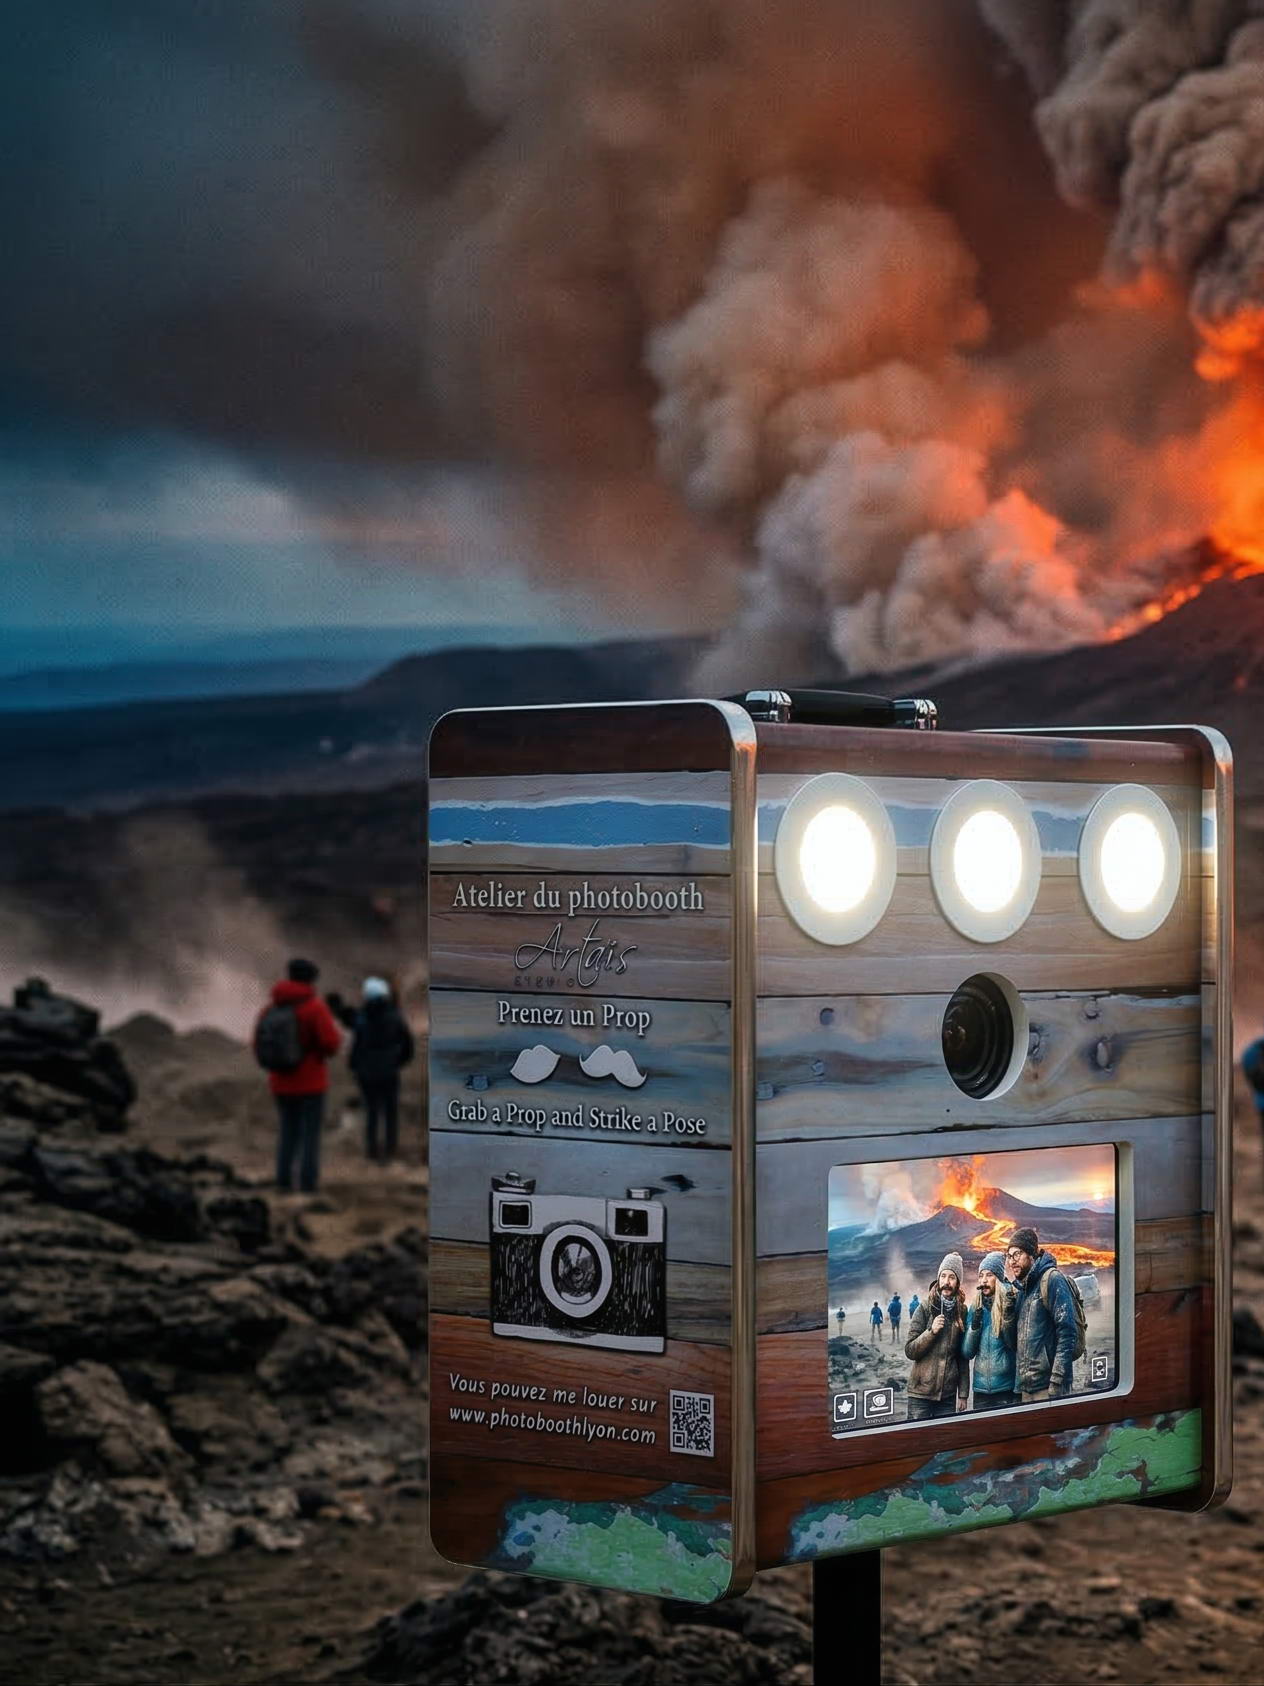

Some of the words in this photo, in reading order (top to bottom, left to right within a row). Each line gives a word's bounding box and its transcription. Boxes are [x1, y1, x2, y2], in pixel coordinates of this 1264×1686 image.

[452, 881, 527, 909] Atelier
[533, 882, 561, 909] du
[568, 882, 705, 916] photobooth
[497, 1000, 564, 1025] Prenez
[570, 1009, 596, 1026] un
[602, 1004, 651, 1037] Prop
[448, 1099, 488, 1121] Grab
[492, 1109, 501, 1122] a
[506, 1103, 546, 1131] Prop
[551, 1105, 584, 1128] and
[588, 1107, 641, 1131] Strike
[647, 1116, 657, 1133] a
[662, 1111, 706, 1134] Pose
[449, 1373, 486, 1394] Vous
[491, 1381, 547, 1401] pouvez
[553, 1387, 576, 1405] me
[582, 1387, 625, 1410] louer
[630, 1397, 657, 1413] sur
[449, 1405, 656, 1444] www.photoboothlyon.com
